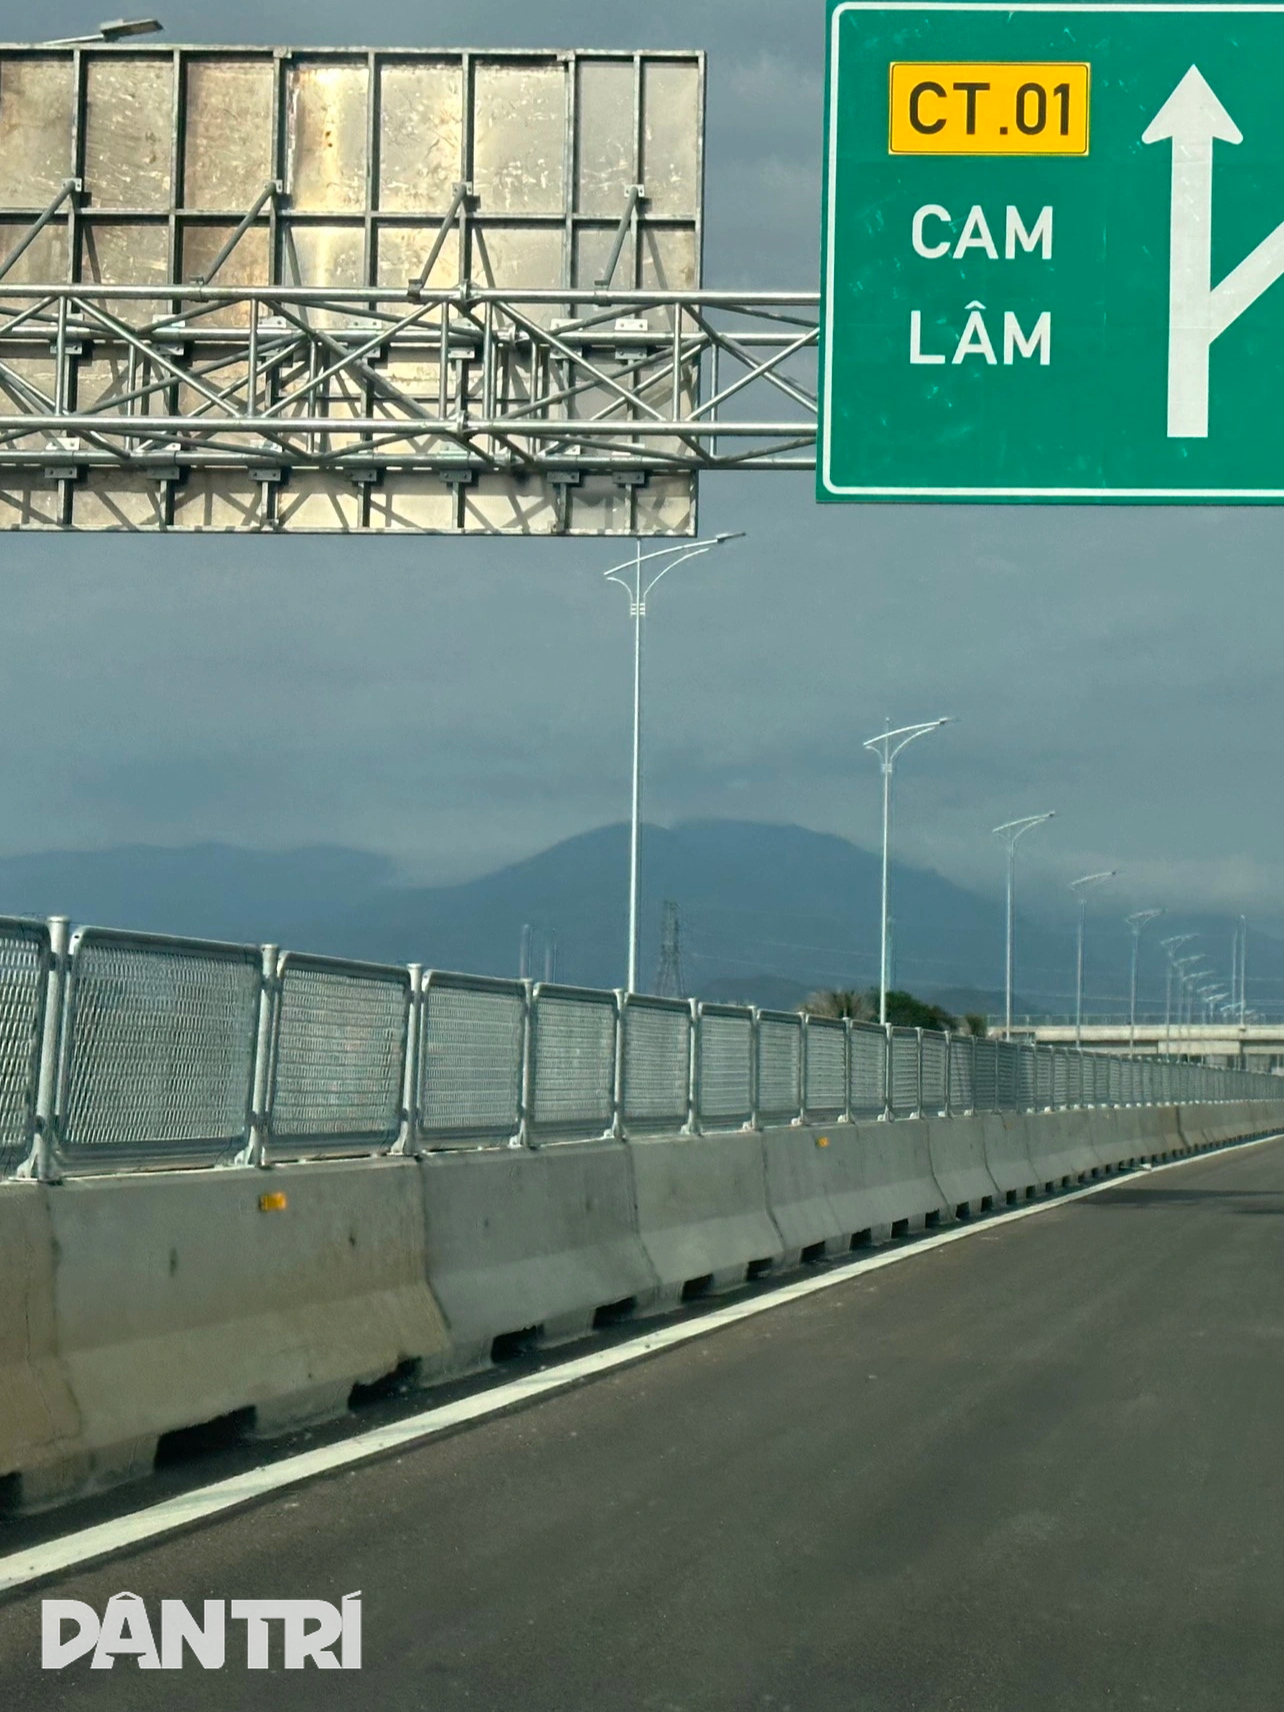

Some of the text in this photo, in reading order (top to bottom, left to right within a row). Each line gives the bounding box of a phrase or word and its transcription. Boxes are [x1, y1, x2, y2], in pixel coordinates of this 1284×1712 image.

[908, 81, 1070, 136] CT.01
[913, 204, 1053, 259] CAM
[910, 299, 1051, 366] LÂM
